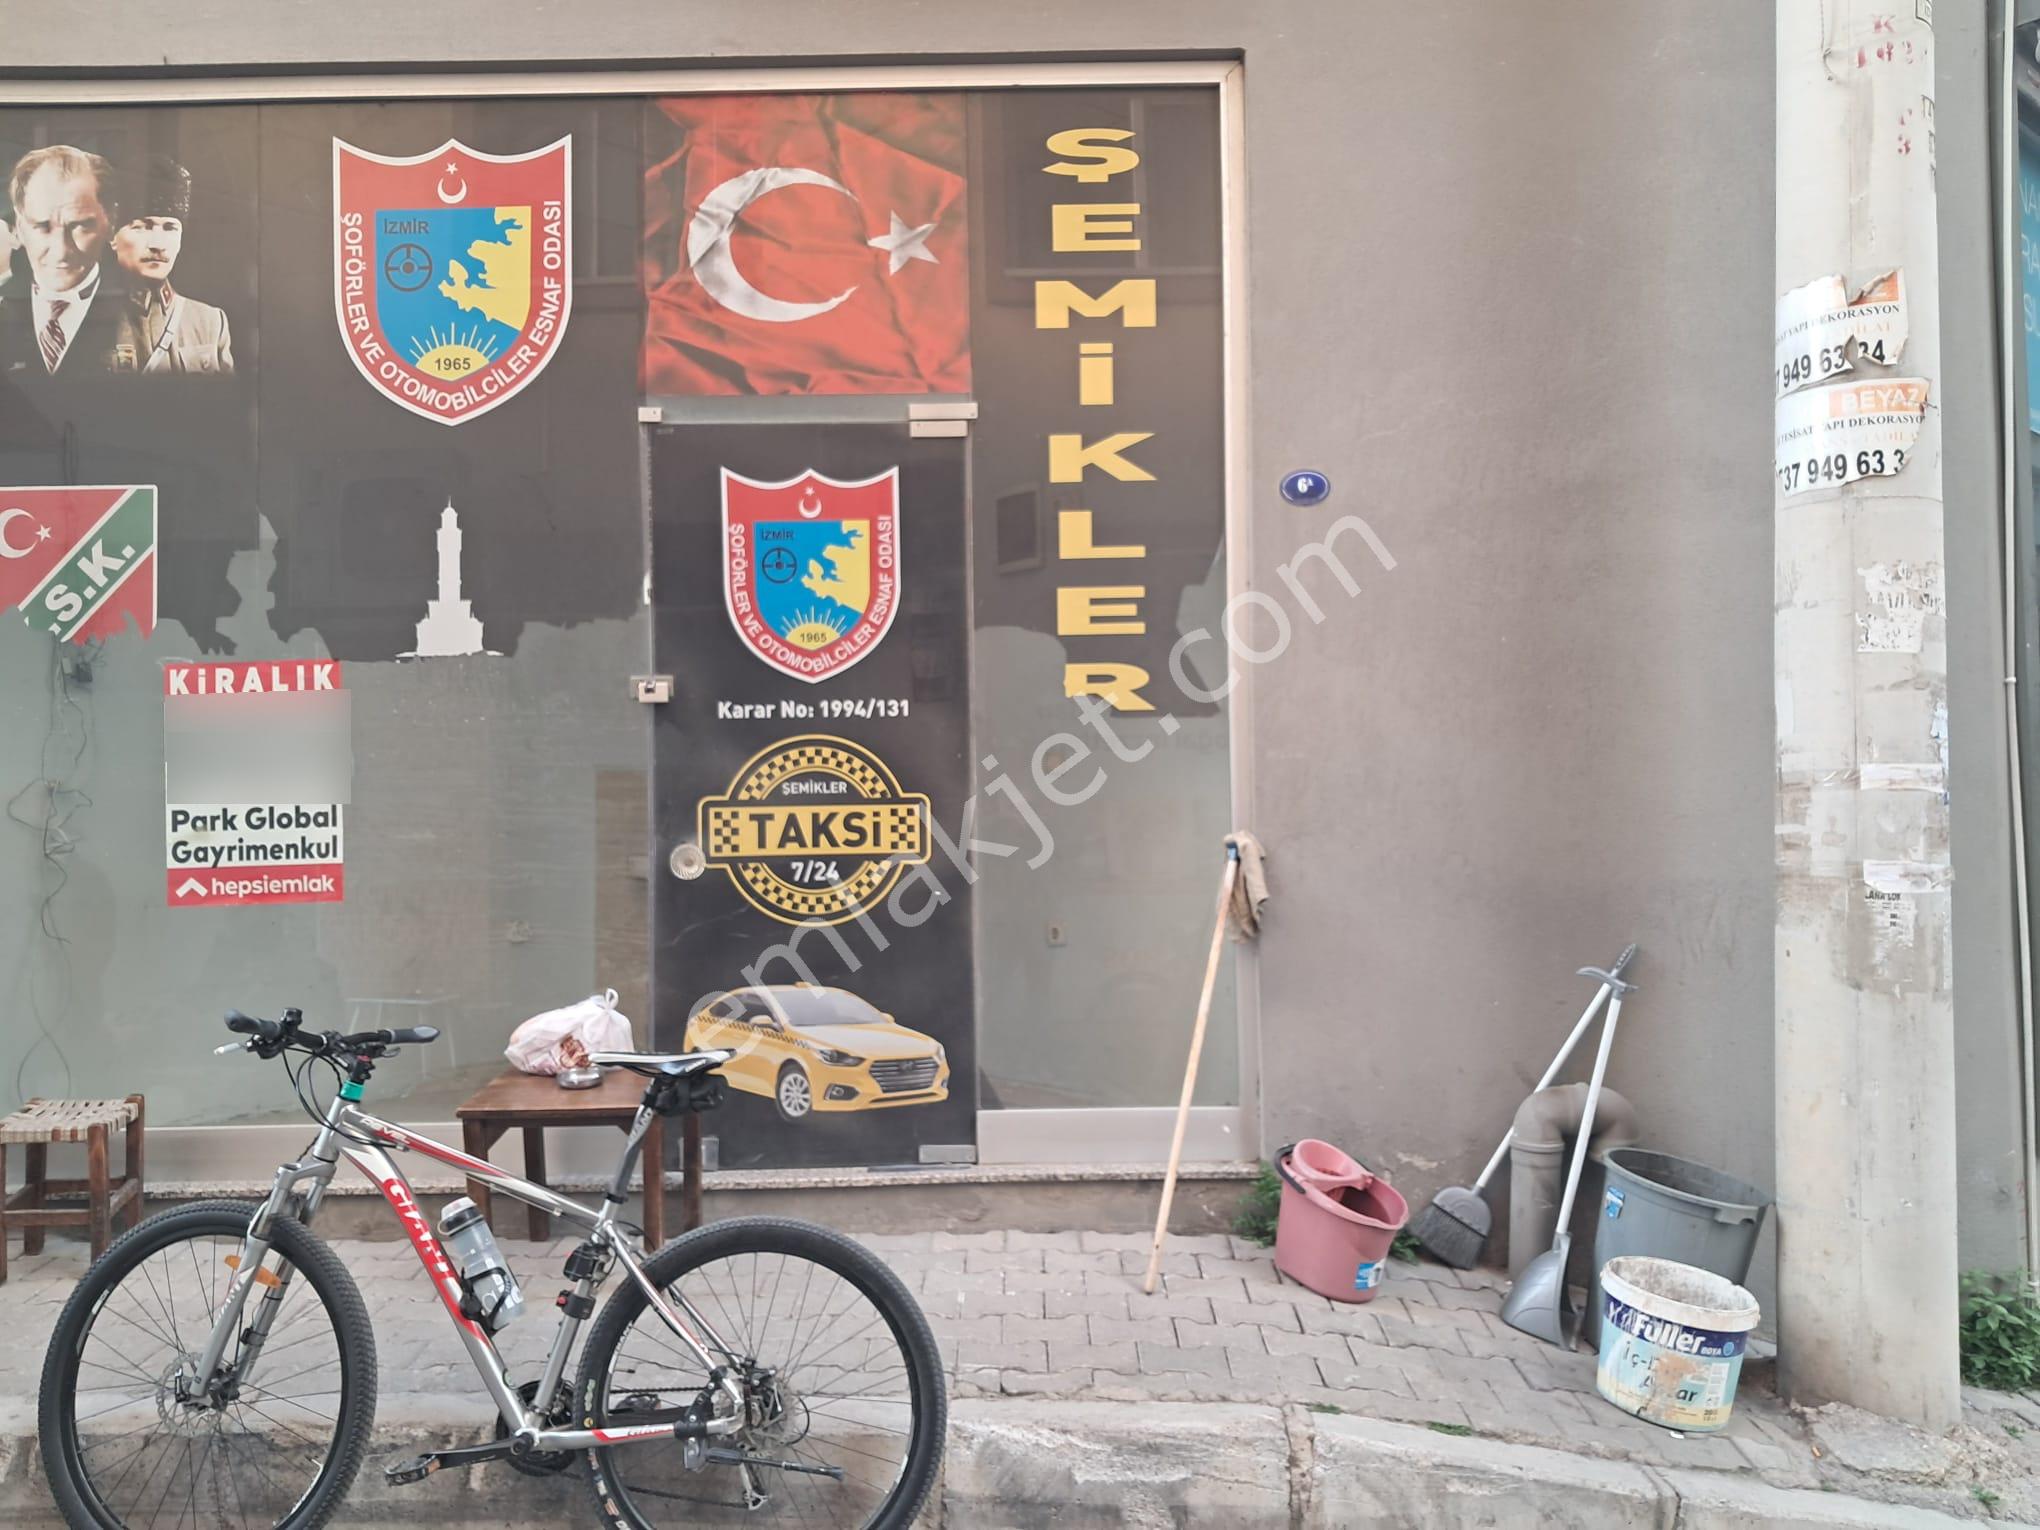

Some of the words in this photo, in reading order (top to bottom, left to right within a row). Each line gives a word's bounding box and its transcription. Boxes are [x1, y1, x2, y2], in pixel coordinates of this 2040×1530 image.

[384, 218, 429, 235] İZMİR
[542, 200, 562, 271] ODASI
[340, 212, 370, 335] ŞOFÖRLER
[528, 277, 562, 346] ESNAF
[359, 332, 386, 365] VE
[434, 357, 471, 371] 1965
[380, 344, 538, 412] OTOMOBİLCİLER
[1783, 354, 1811, 388] 949
[1849, 414, 1925, 428] DEKORASYO
[1807, 453, 1848, 484] 949
[1856, 449, 1885, 476] 63
[761, 528, 794, 541] İZMİR
[877, 515, 893, 568] ODASI
[728, 523, 751, 616] ŞOFÖRLER
[869, 574, 894, 626] ESNAF
[743, 613, 763, 638] VE
[800, 632, 827, 643] 1965
[759, 623, 876, 673] OTOMOBİLCİLER
[718, 701, 775, 719] Karar
[781, 700, 814, 719] No:
[820, 698, 909, 720] 1994/131
[782, 779, 847, 796] ŞEMİKLER
[171, 807, 239, 832] Park
[245, 803, 338, 830] Global
[171, 835, 338, 868] Gayrimenkul
[211, 873, 335, 898] hepsiemlak
[791, 860, 839, 883] 7/24
